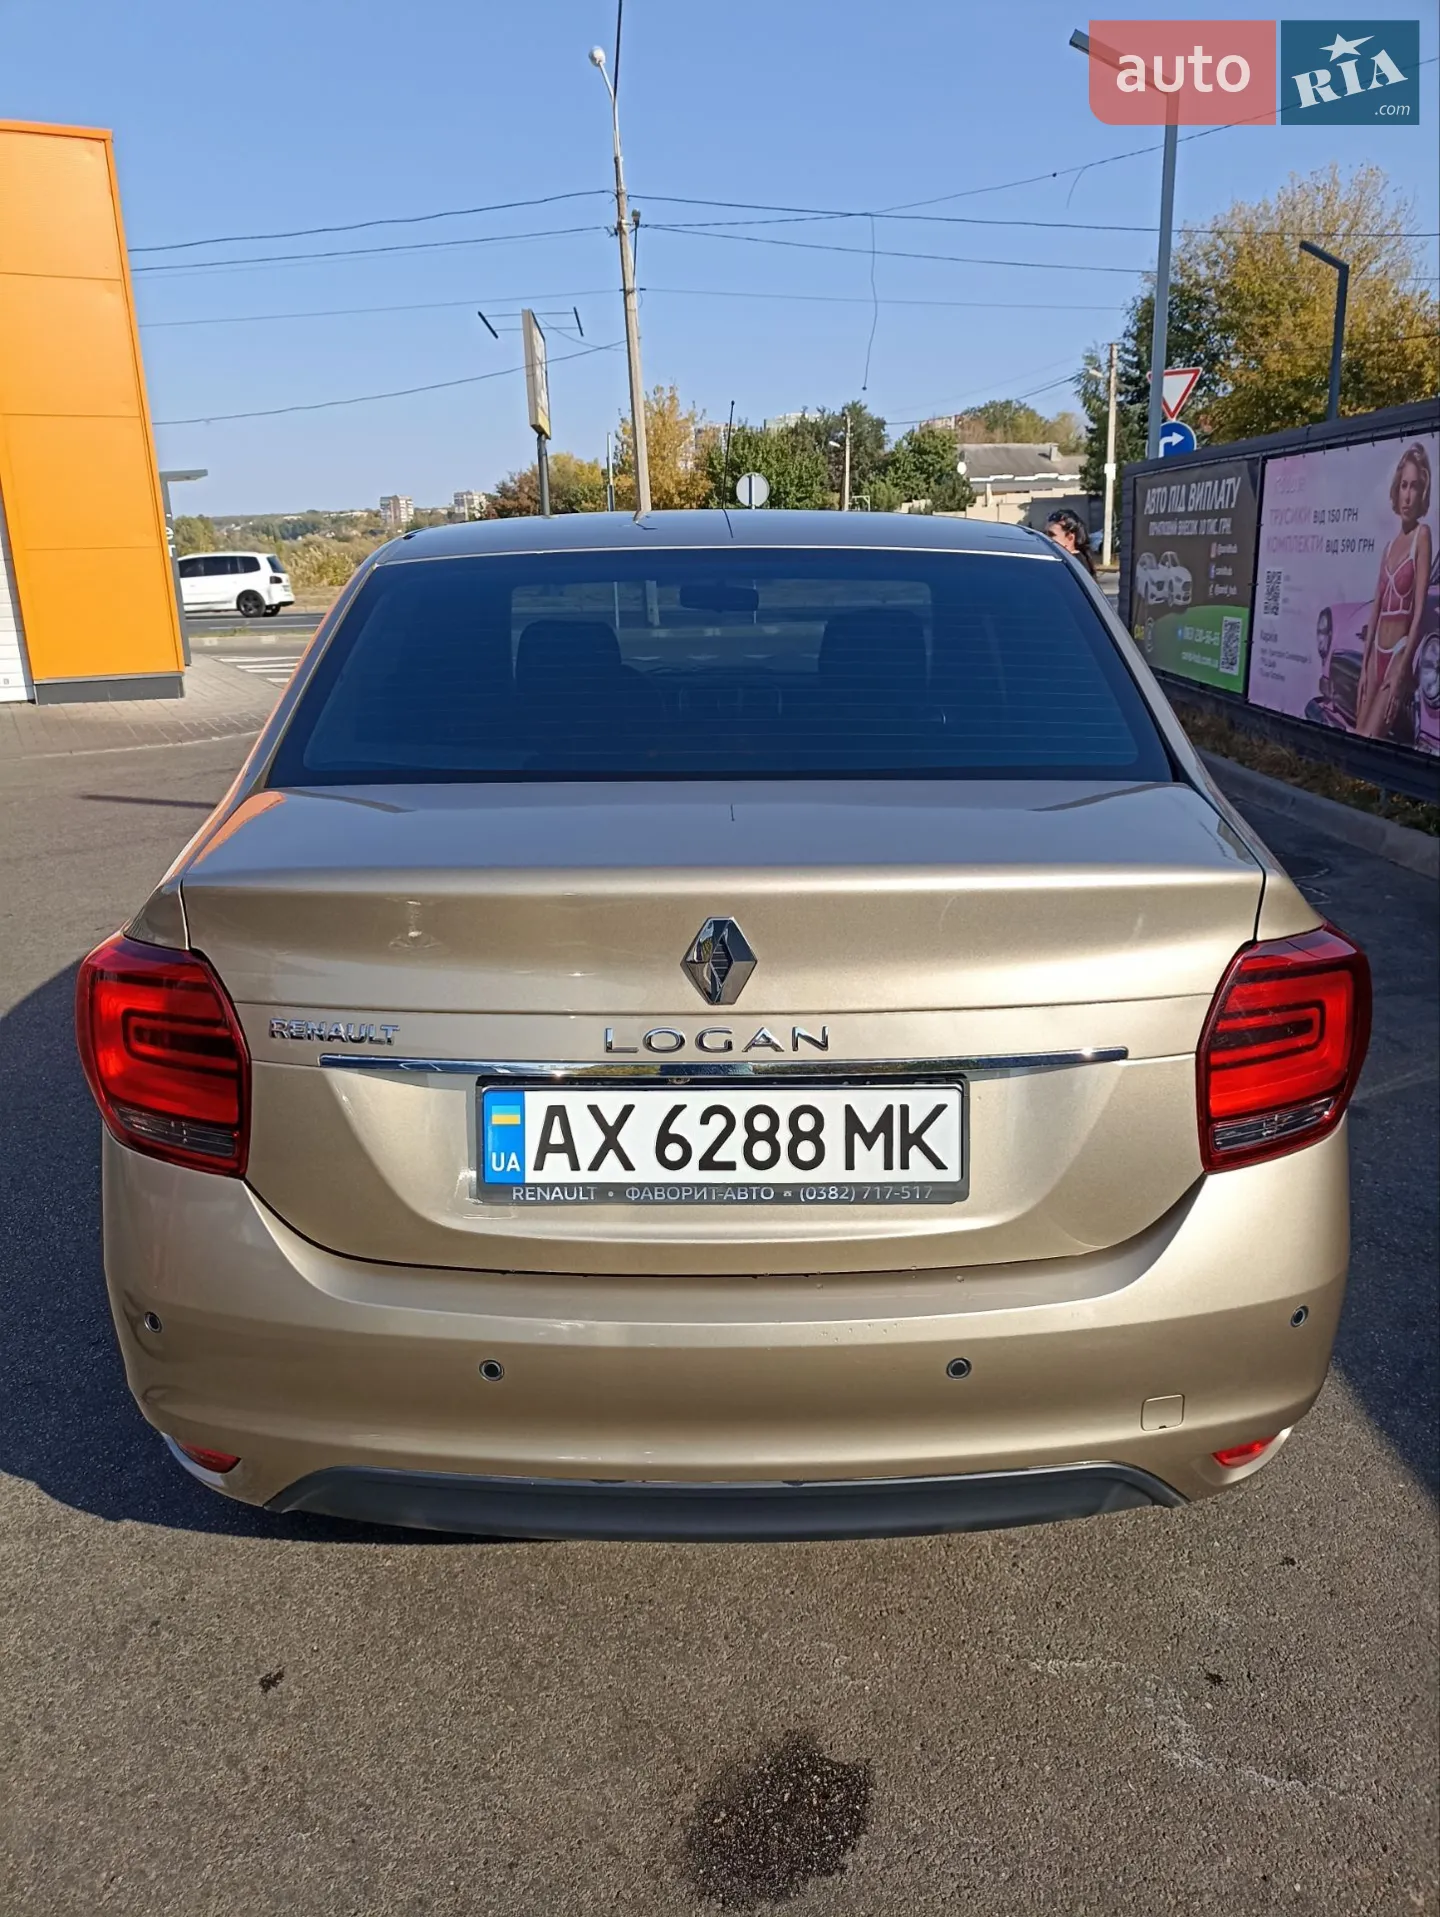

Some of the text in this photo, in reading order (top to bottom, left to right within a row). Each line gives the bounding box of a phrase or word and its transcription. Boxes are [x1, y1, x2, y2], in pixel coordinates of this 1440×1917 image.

[1144, 486, 1168, 515] АВТО
[1168, 484, 1187, 513] ПІД
[1187, 476, 1241, 511] ВИПЛАТУ
[1269, 507, 1359, 525] ТРУСИКИ ВІД 150 ГРН
[1267, 535, 1375, 555] КОМПЛЕКТИ ВІД 590 ГРН
[269, 1018, 400, 1046] RENAULT
[604, 1026, 830, 1054] LOGAN
[533, 1104, 949, 1172] AX 6288 MK
[491, 1151, 521, 1172] UA
[512, 1185, 933, 1202] RENAULT ФАВОРИТ-АВТО (0382) 717-517
